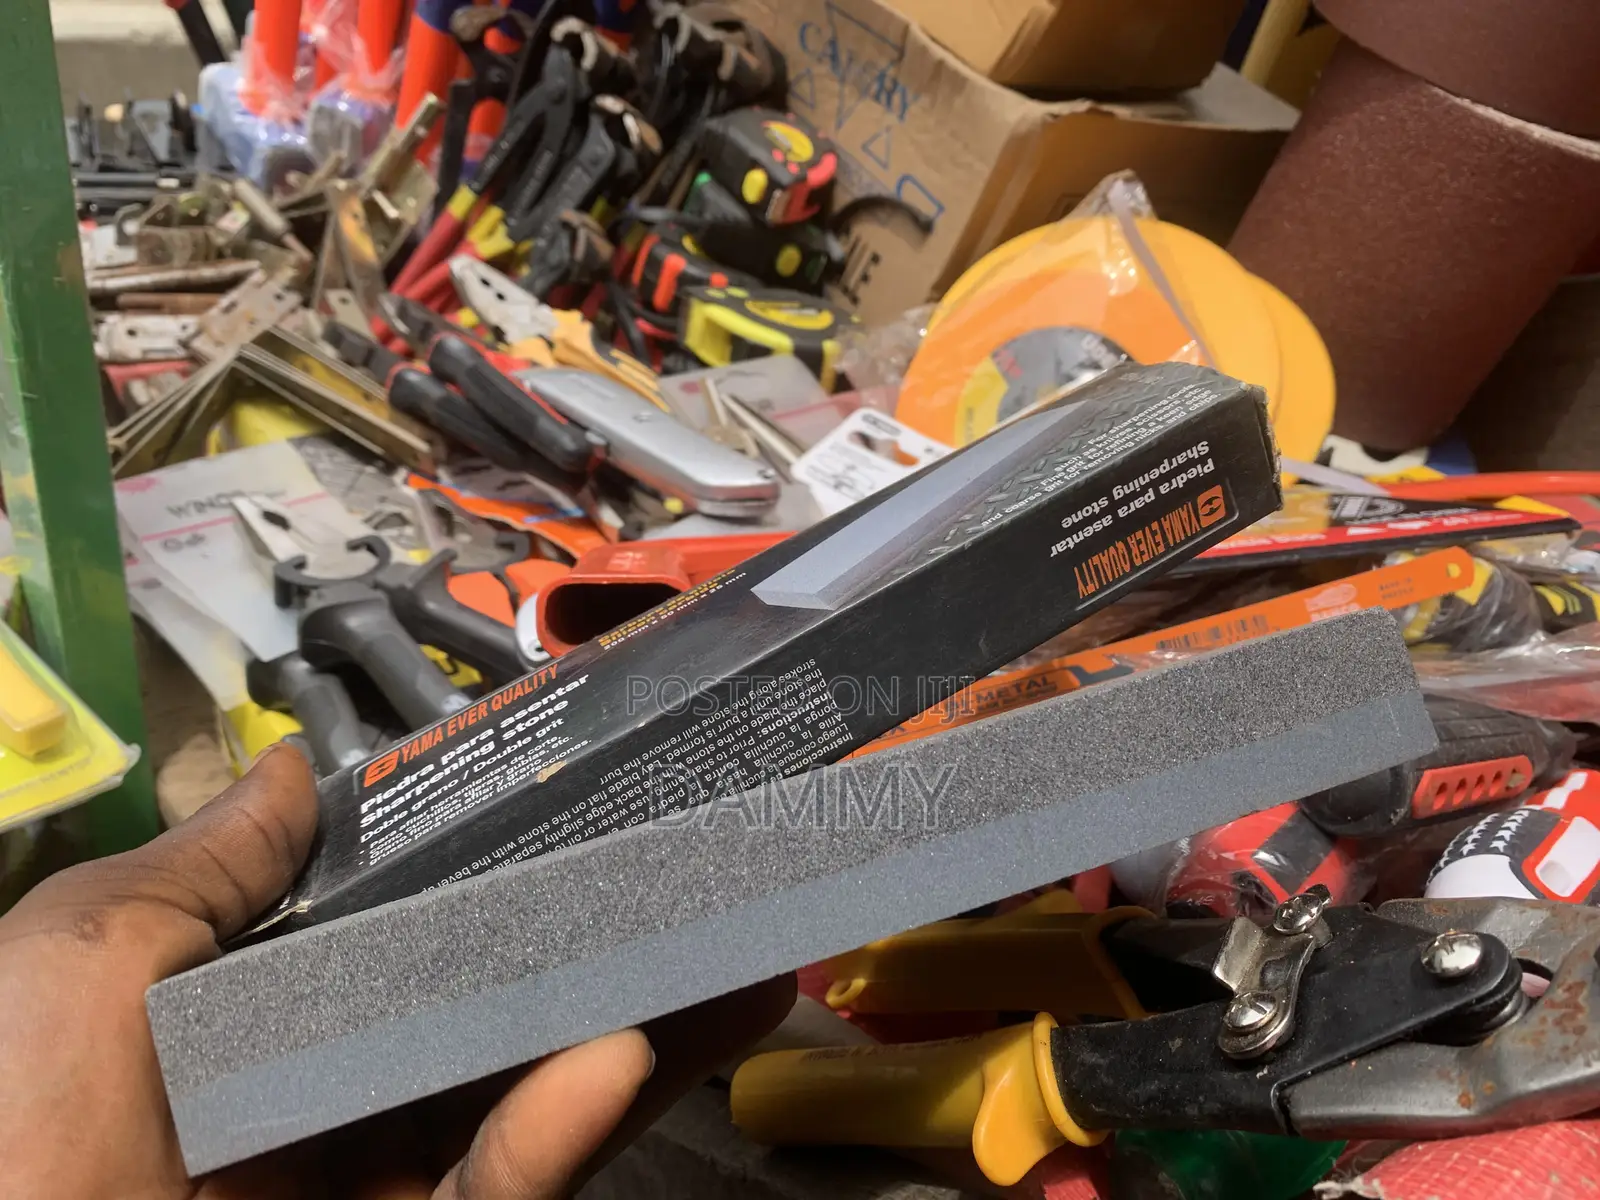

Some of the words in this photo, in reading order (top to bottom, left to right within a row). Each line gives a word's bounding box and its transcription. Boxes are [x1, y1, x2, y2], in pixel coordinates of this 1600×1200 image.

[1053, 455, 1082, 472] such
[1112, 440, 1210, 501] Sharpening
[1158, 457, 1215, 495] Piedra
[1061, 496, 1109, 529] stone
[1117, 487, 1156, 518] para
[981, 512, 1003, 528] and
[1166, 501, 1201, 547] YAMA
[1050, 514, 1113, 558] asentar
[1133, 519, 1167, 566] EVER
[1073, 537, 1131, 599] QUALITY
[778, 658, 816, 684] strokes
[804, 668, 823, 682] the
[748, 677, 778, 703] along
[773, 678, 804, 701] stone
[798, 677, 827, 703] place
[402, 731, 444, 764] YAMA
[447, 703, 488, 737] EVER
[491, 664, 559, 711] QUALITY
[730, 696, 749, 712] the
[749, 696, 773, 716] until
[756, 690, 833, 738] Instructions:
[780, 696, 799, 710] the
[803, 699, 840, 725] ponga
[701, 706, 732, 728] stone
[717, 714, 741, 733] burr
[740, 710, 749, 719] a
[750, 706, 782, 728] blade
[818, 711, 842, 730] Afile
[682, 724, 701, 740] will
[705, 728, 718, 739] is
[734, 724, 749, 737] on
[789, 722, 802, 733] la
[800, 729, 813, 740] la
[817, 722, 849, 744] Luego
[360, 763, 435, 814] Piedra
[440, 728, 495, 766] para
[500, 674, 589, 729] asentar
[641, 734, 682, 761] remove
[662, 735, 706, 766] formed.
[716, 732, 735, 747] the
[728, 735, 756, 755] Prior
[743, 731, 786, 760] cuchilla
[359, 740, 496, 828] Sharpening
[502, 700, 569, 741] stone
[622, 757, 642, 771] the
[622, 757, 642, 771] the
[685, 743, 716, 765] stone
[716, 751, 728, 761] to
[753, 739, 795, 768] cuchilla
[777, 740, 817, 767] coloque
[783, 732, 854, 776] Instrucciones
[599, 767, 624, 786] burr
[641, 759, 663, 776] Lay
[648, 758, 715, 797] sharpening,
[661, 761, 687, 779] with
[704, 758, 740, 782] contra
[715, 767, 749, 789] hasta
[766, 763, 780, 773] la
[360, 810, 409, 844] Doble
[411, 778, 459, 812] grano
[472, 736, 532, 773] Double
[535, 718, 565, 739] grit
[607, 771, 641, 794] blade
[642, 774, 663, 791] the
[687, 779, 702, 791] la
[729, 770, 767, 797] cuchilla
[369, 830, 397, 849] Para
[398, 809, 430, 831] afilar
[430, 763, 508, 812] herramientas
[510, 754, 526, 765] de
[587, 790, 608, 807] flat
[613, 785, 643, 805] back
[629, 795, 652, 811] use
[648, 787, 686, 815] piedra
[688, 789, 710, 805] que
[369, 835, 408, 859] Grano
[408, 820, 433, 836] fino
[434, 803, 462, 823] para
[496, 778, 504, 790] y
[506, 758, 542, 784] grano
[551, 810, 572, 825] the
[571, 801, 587, 814] on
[585, 801, 614, 821] edge
[369, 838, 413, 866] grueso
[414, 821, 442, 841] para
[444, 790, 495, 823] remover
[597, 808, 629, 830] water
[623, 812, 645, 831] con
[517, 821, 551, 844] stone
[544, 817, 585, 845] slightly
[583, 826, 596, 838] or
[369, 832, 404, 855] como
[491, 841, 517, 859] with
[471, 855, 492, 870] the
[482, 841, 543, 875] separate
